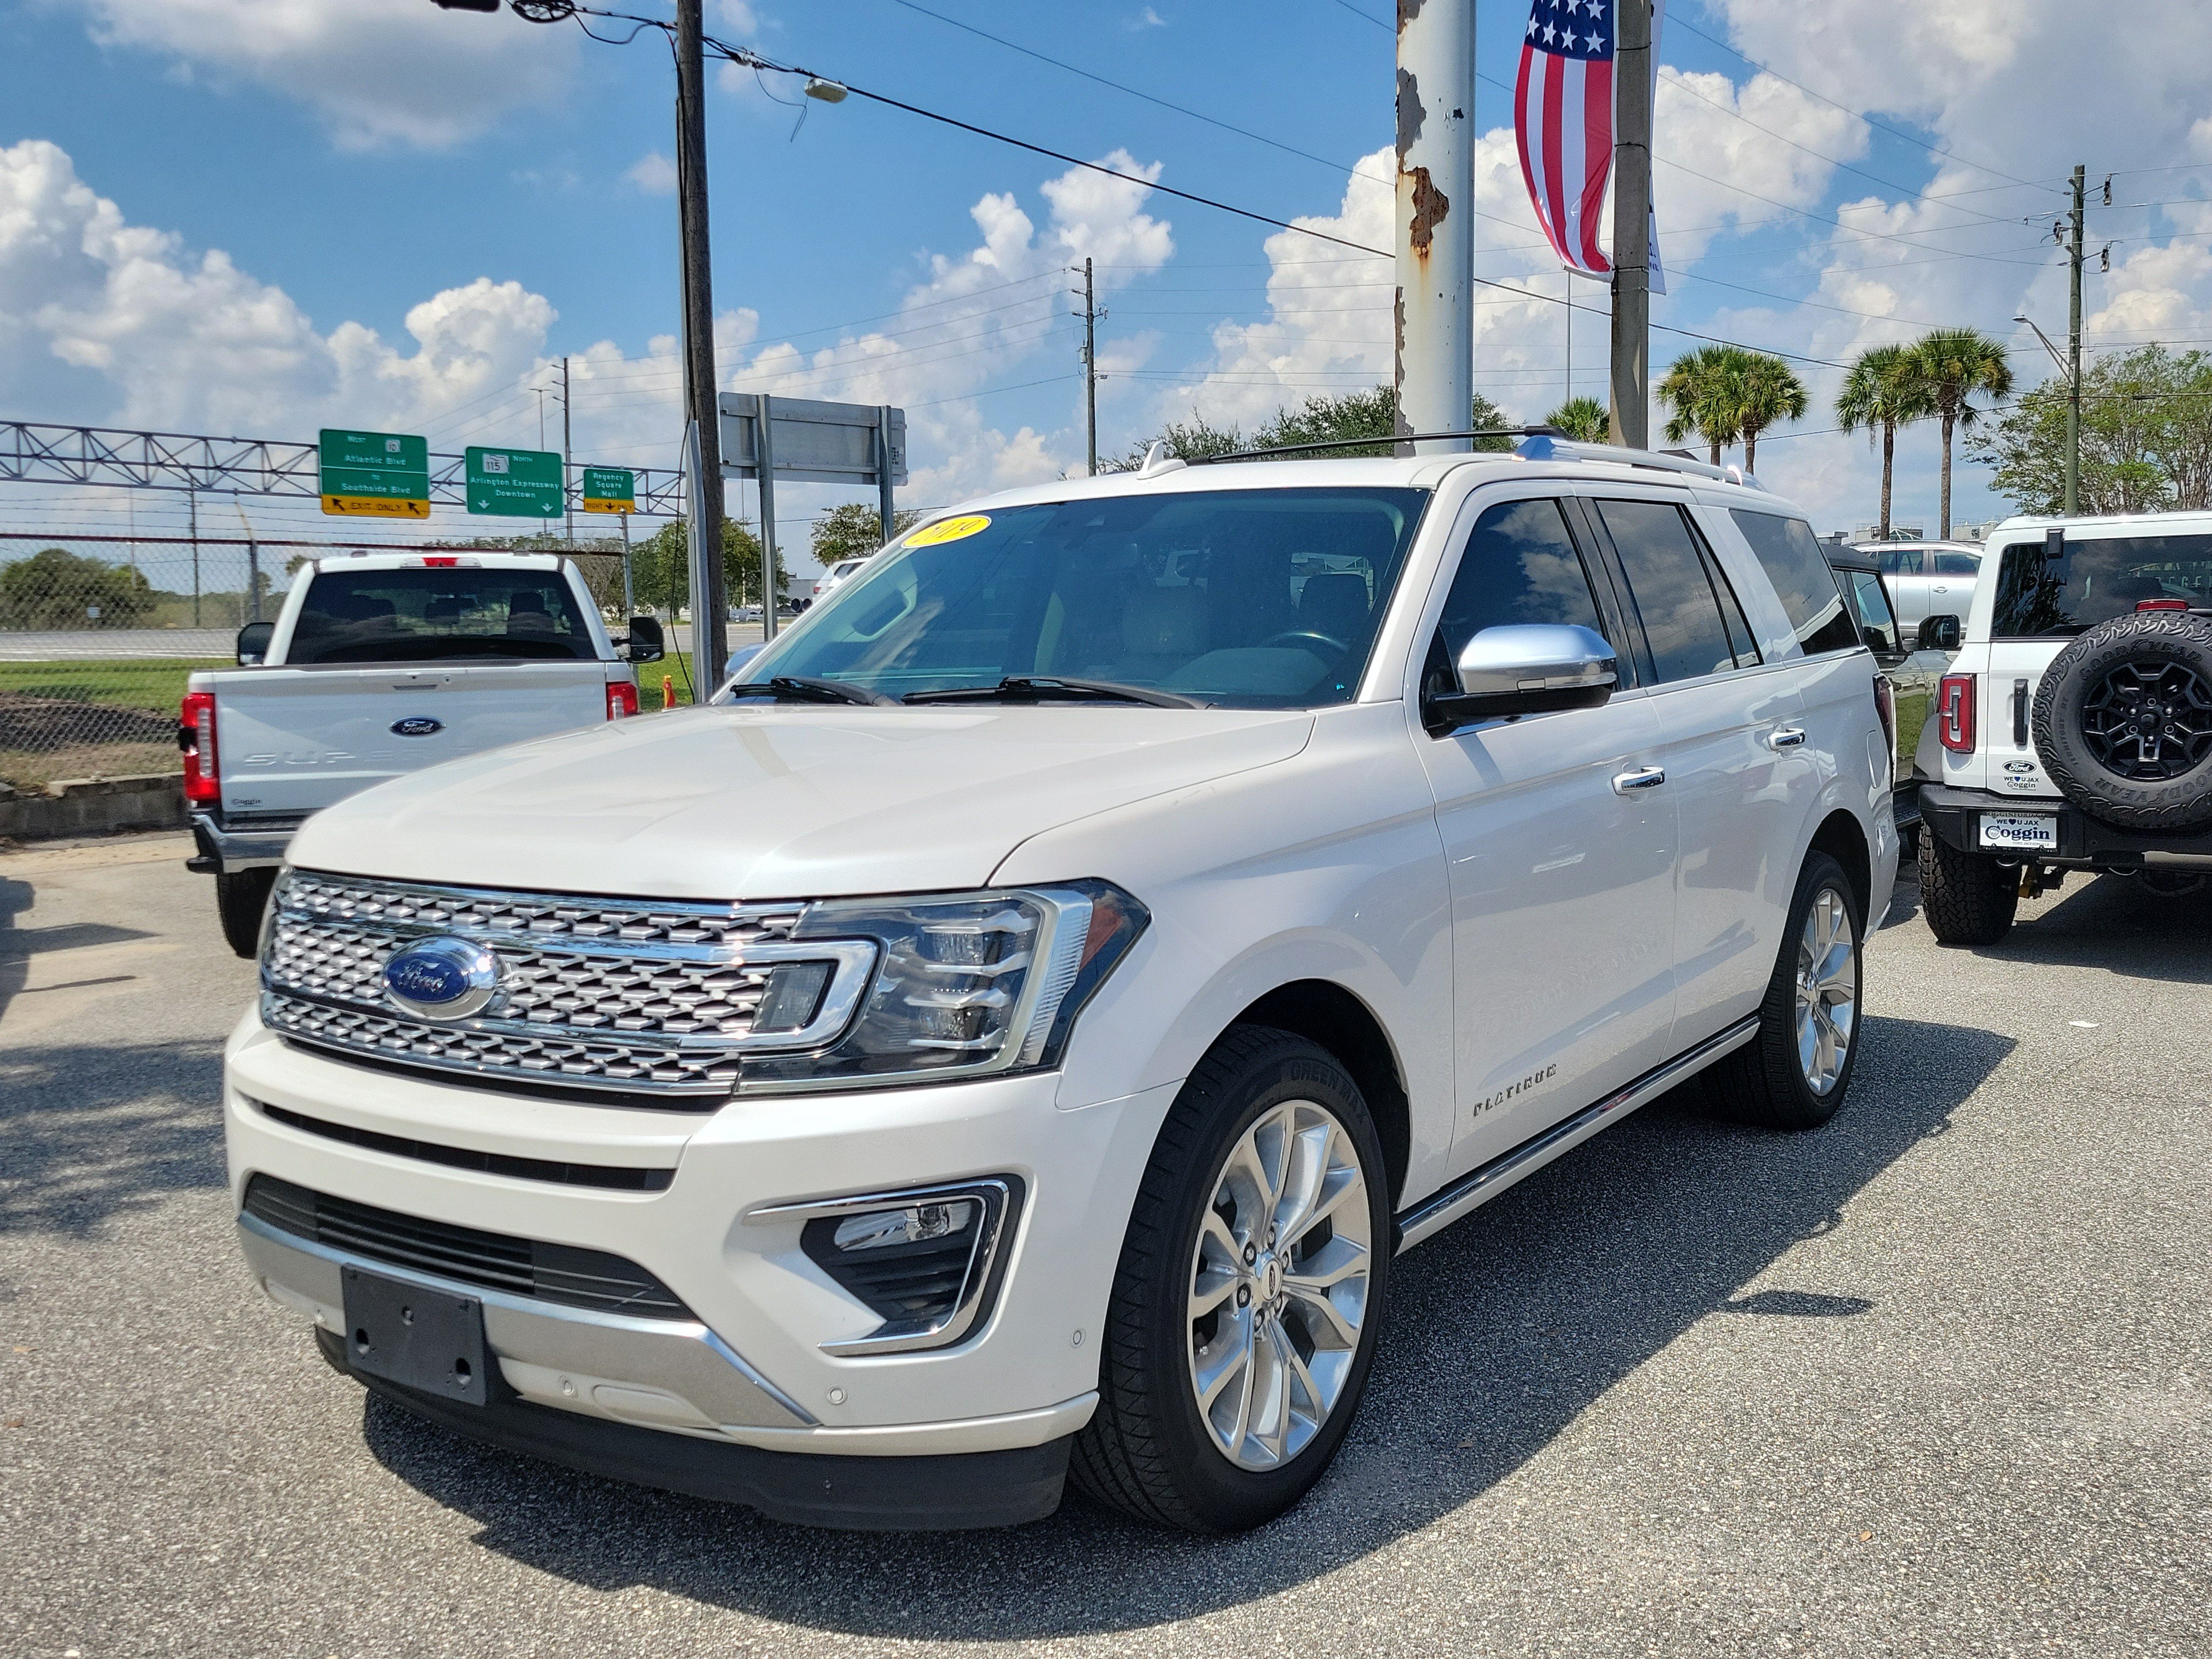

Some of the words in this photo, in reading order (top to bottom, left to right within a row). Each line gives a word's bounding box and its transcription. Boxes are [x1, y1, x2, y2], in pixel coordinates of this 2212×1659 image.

[344, 455, 383, 464] Atlantic
[486, 462, 500, 471] 115
[593, 473, 624, 482] Regency
[341, 483, 387, 493] Southside
[471, 477, 510, 487] Arlington
[512, 479, 559, 490] Expressway
[496, 489, 536, 498] Downtown
[601, 490, 617, 498] Mall
[2080, 639, 2202, 680] GOODYEAR
[402, 720, 434, 733] Ford
[1985, 825, 2050, 841] Coggin
[398, 960, 451, 992] Ford
[1474, 1063, 1557, 1118] PLATINUM
